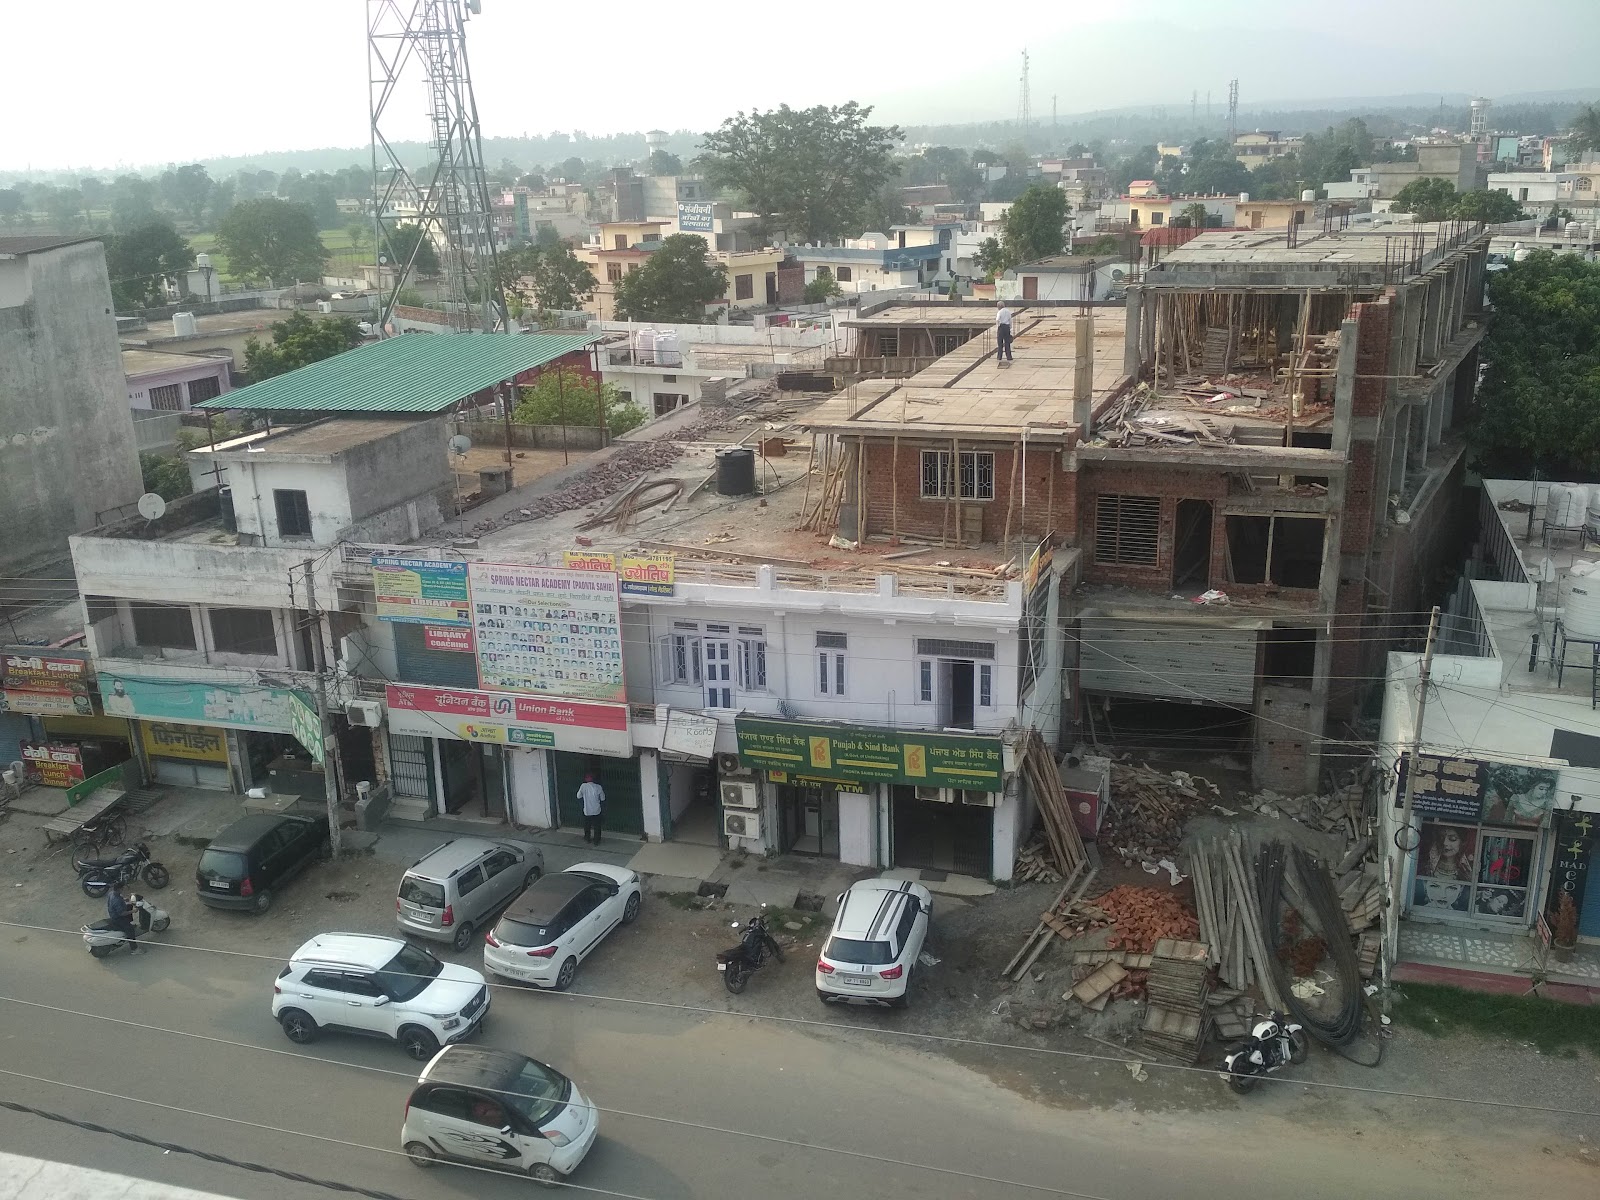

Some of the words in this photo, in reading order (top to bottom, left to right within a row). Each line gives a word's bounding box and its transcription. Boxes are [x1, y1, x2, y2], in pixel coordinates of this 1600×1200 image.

[684, 204, 711, 214] संजीवनी
[624, 564, 670, 582] ज्योतिष
[490, 574, 514, 586] SPRING
[516, 576, 539, 588] NECTAR
[541, 578, 570, 590] ACADEMY
[596, 583, 615, 592] SAHIB)
[410, 598, 452, 607] LIBRARY
[429, 631, 466, 639] LIBRARY
[430, 640, 468, 648] COACHING
[8, 667, 49, 676] Breakfast
[435, 694, 469, 706] यूनियन
[471, 696, 486, 708] बैंक
[519, 702, 546, 713] Union
[549, 706, 575, 717] Bank
[738, 731, 758, 742] पंजाब
[760, 735, 775, 744] एण्ड
[776, 733, 791, 745] सिंध
[793, 735, 806, 746] बैंक
[832, 740, 856, 750] Punjab
[857, 742, 863, 750] &
[864, 742, 880, 751] Sind
[882, 744, 900, 753] Bank
[23, 745, 49, 759] नेगी
[35, 760, 69, 770] Breakfast
[44, 778, 67, 786] Dinner
[835, 784, 863, 793] ATM
[1560, 860, 1586, 870] MAD
